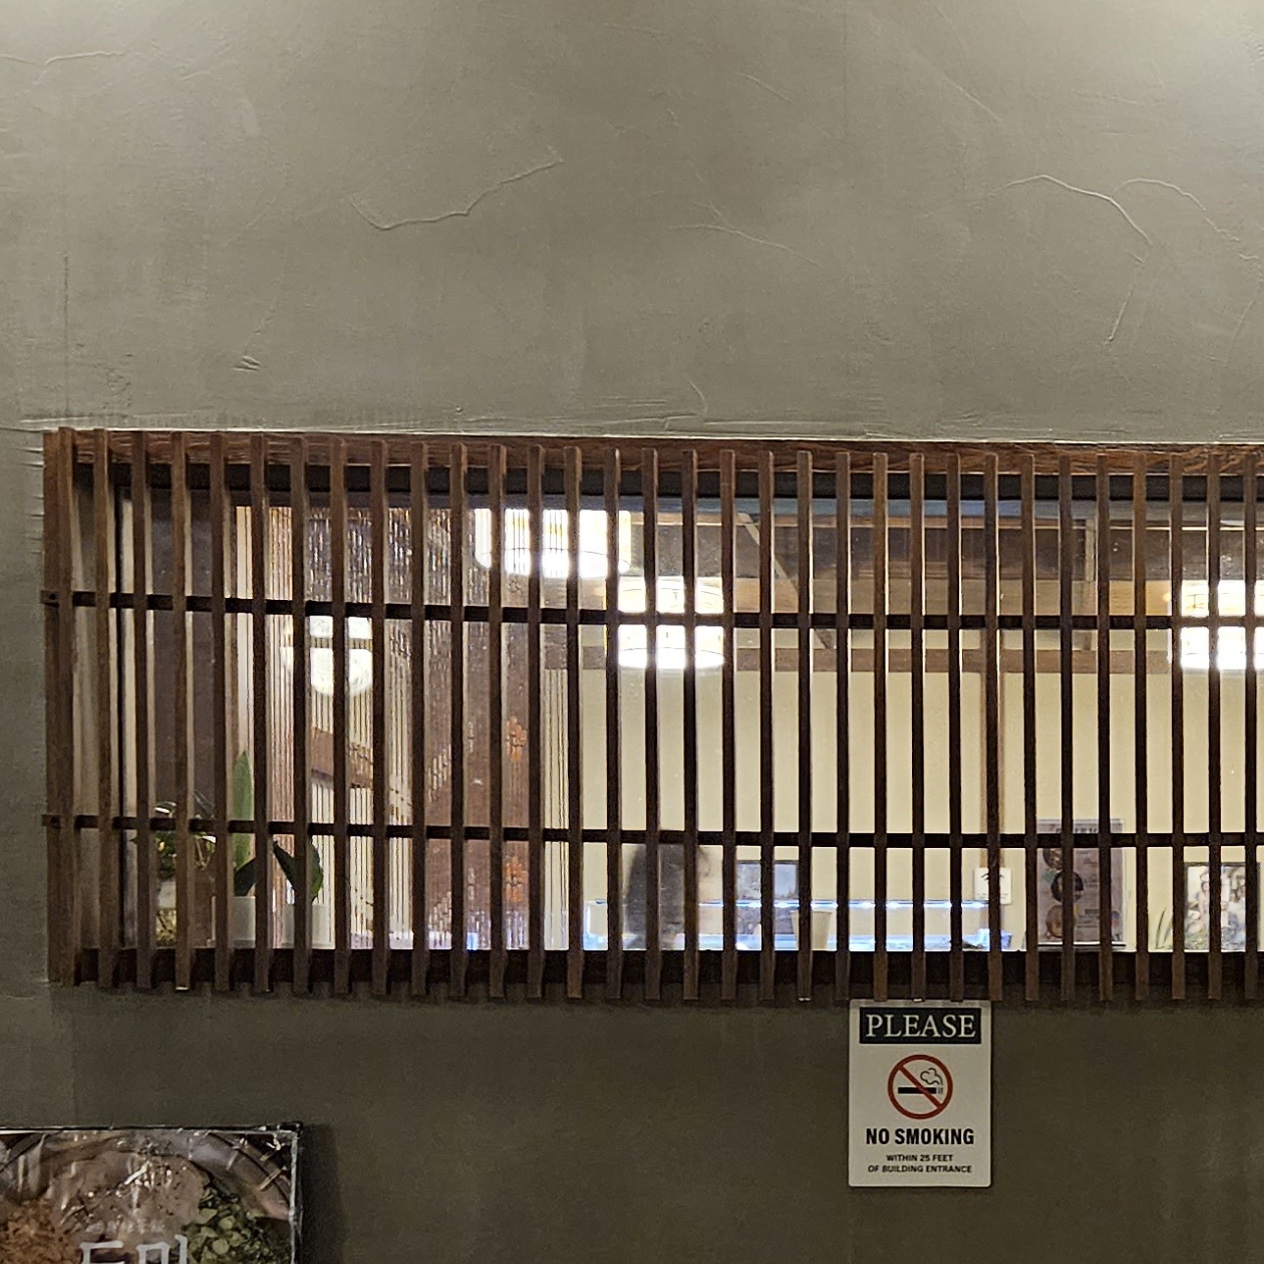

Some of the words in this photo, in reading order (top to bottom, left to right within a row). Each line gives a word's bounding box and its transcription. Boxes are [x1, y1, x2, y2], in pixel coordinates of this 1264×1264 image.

[865, 1014, 976, 1038] PLEASE
[866, 1128, 890, 1145] NO
[894, 1128, 974, 1145] SMOKING
[886, 1154, 918, 1162] WITHIN
[919, 1154, 930, 1162] 25
[932, 1154, 954, 1162] FEET
[867, 1165, 879, 1173] OF
[882, 1165, 923, 1173] BUILDING
[926, 1165, 973, 1173] ENTRANCE
